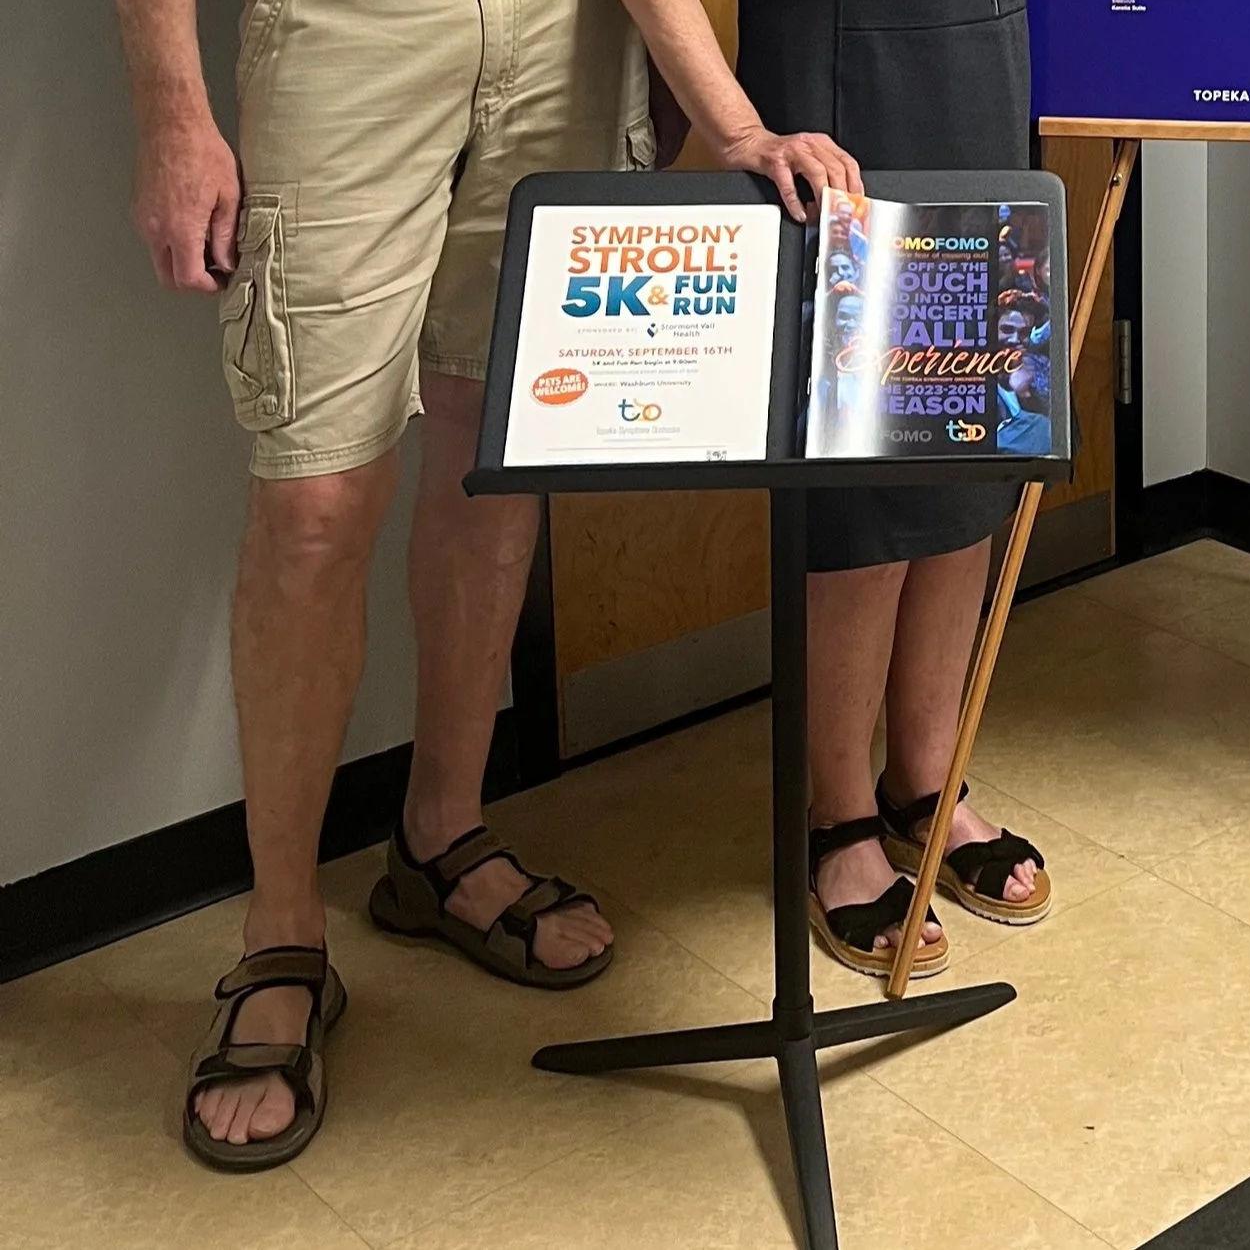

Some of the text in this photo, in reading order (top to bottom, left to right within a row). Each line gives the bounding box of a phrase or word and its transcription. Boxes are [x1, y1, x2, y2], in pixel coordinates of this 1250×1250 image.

[1193, 89, 1250, 103] TOPEKA
[571, 225, 743, 245] SYMPHONY
[892, 237, 990, 251] OMOFOMO
[567, 245, 738, 274] STROLL:
[907, 262, 988, 272] OFF OF THE
[674, 274, 737, 294] FUN
[897, 272, 988, 293] OUCH
[561, 275, 669, 318] 5K &
[915, 293, 953, 303] INTO
[957, 293, 988, 303] THE
[672, 296, 736, 316] RUN
[892, 305, 988, 321] ONCERT
[700, 322, 715, 330] Vail
[673, 330, 701, 338] Health
[558, 346, 733, 358] SATURDAY, SEPTEMBER 16TH
[644, 359, 664, 367] begin
[538, 374, 582, 388] PETS ARE
[620, 379, 692, 388] Washburn University
[534, 382, 586, 398] WELCOME!
[905, 384, 987, 395] 2023-2024
